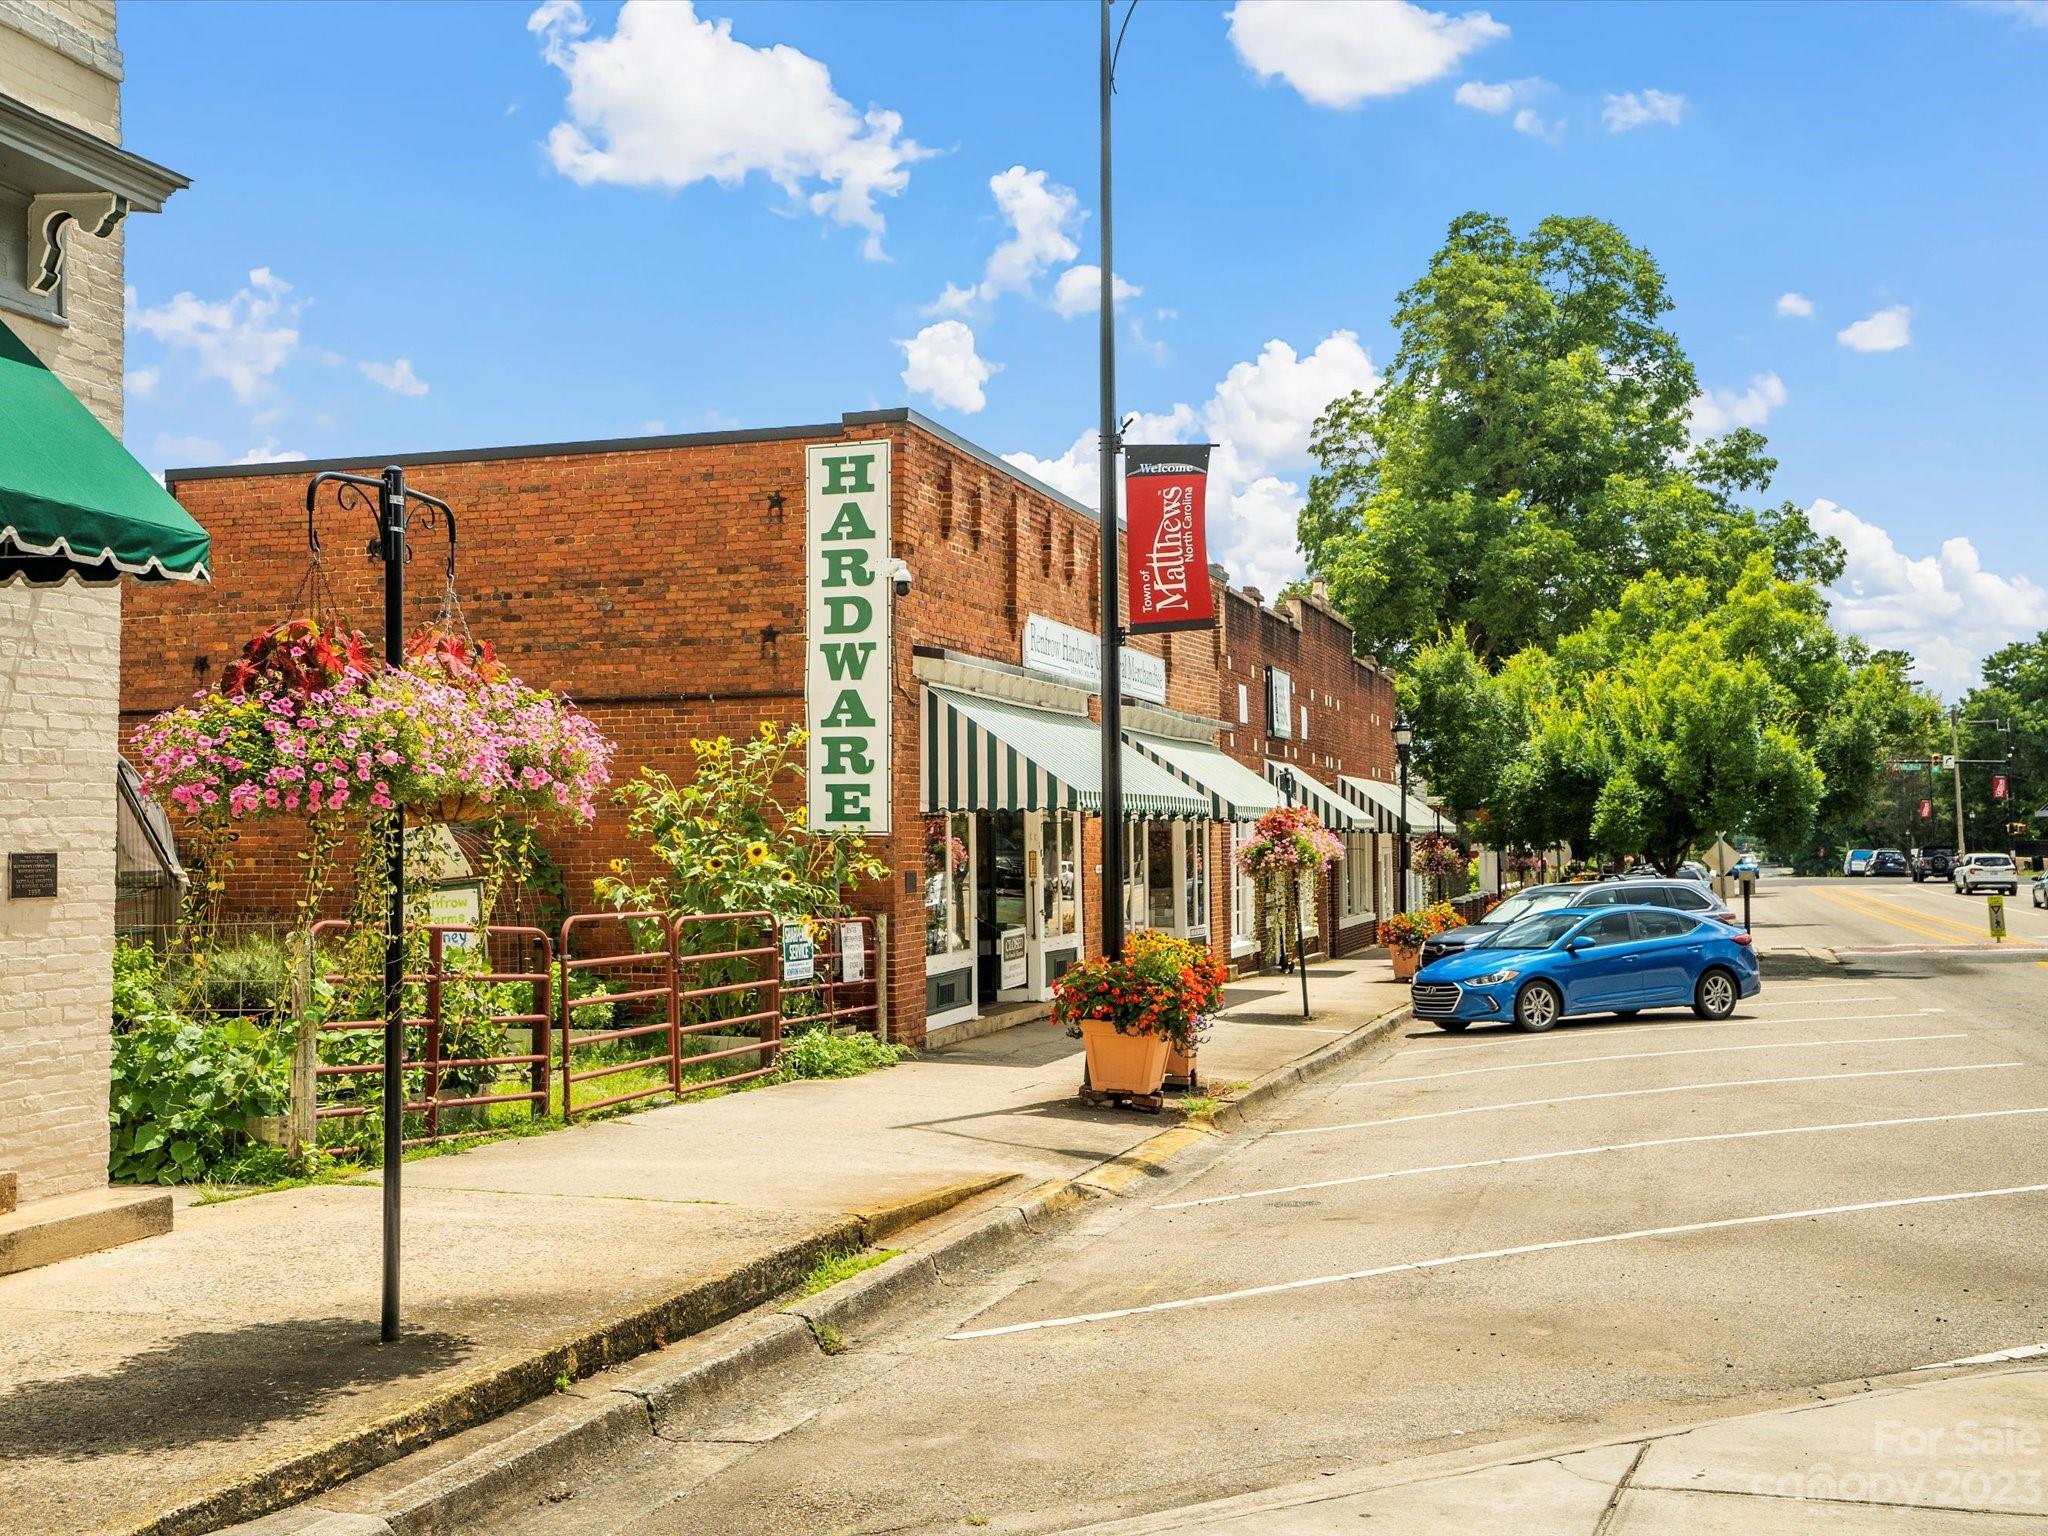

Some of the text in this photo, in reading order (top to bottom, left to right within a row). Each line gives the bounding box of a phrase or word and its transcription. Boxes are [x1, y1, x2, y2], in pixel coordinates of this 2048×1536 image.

[1139, 463, 1193, 473] Welcome
[1182, 486, 1194, 562] North Carolina
[1146, 486, 1189, 612] Matthews
[1140, 570, 1152, 613] Town of
[819, 454, 877, 822] HARDWARE
[1030, 622, 1062, 660] Renfrow
[1062, 633, 1094, 669] Hardware
[431, 895, 467, 910] nfrow
